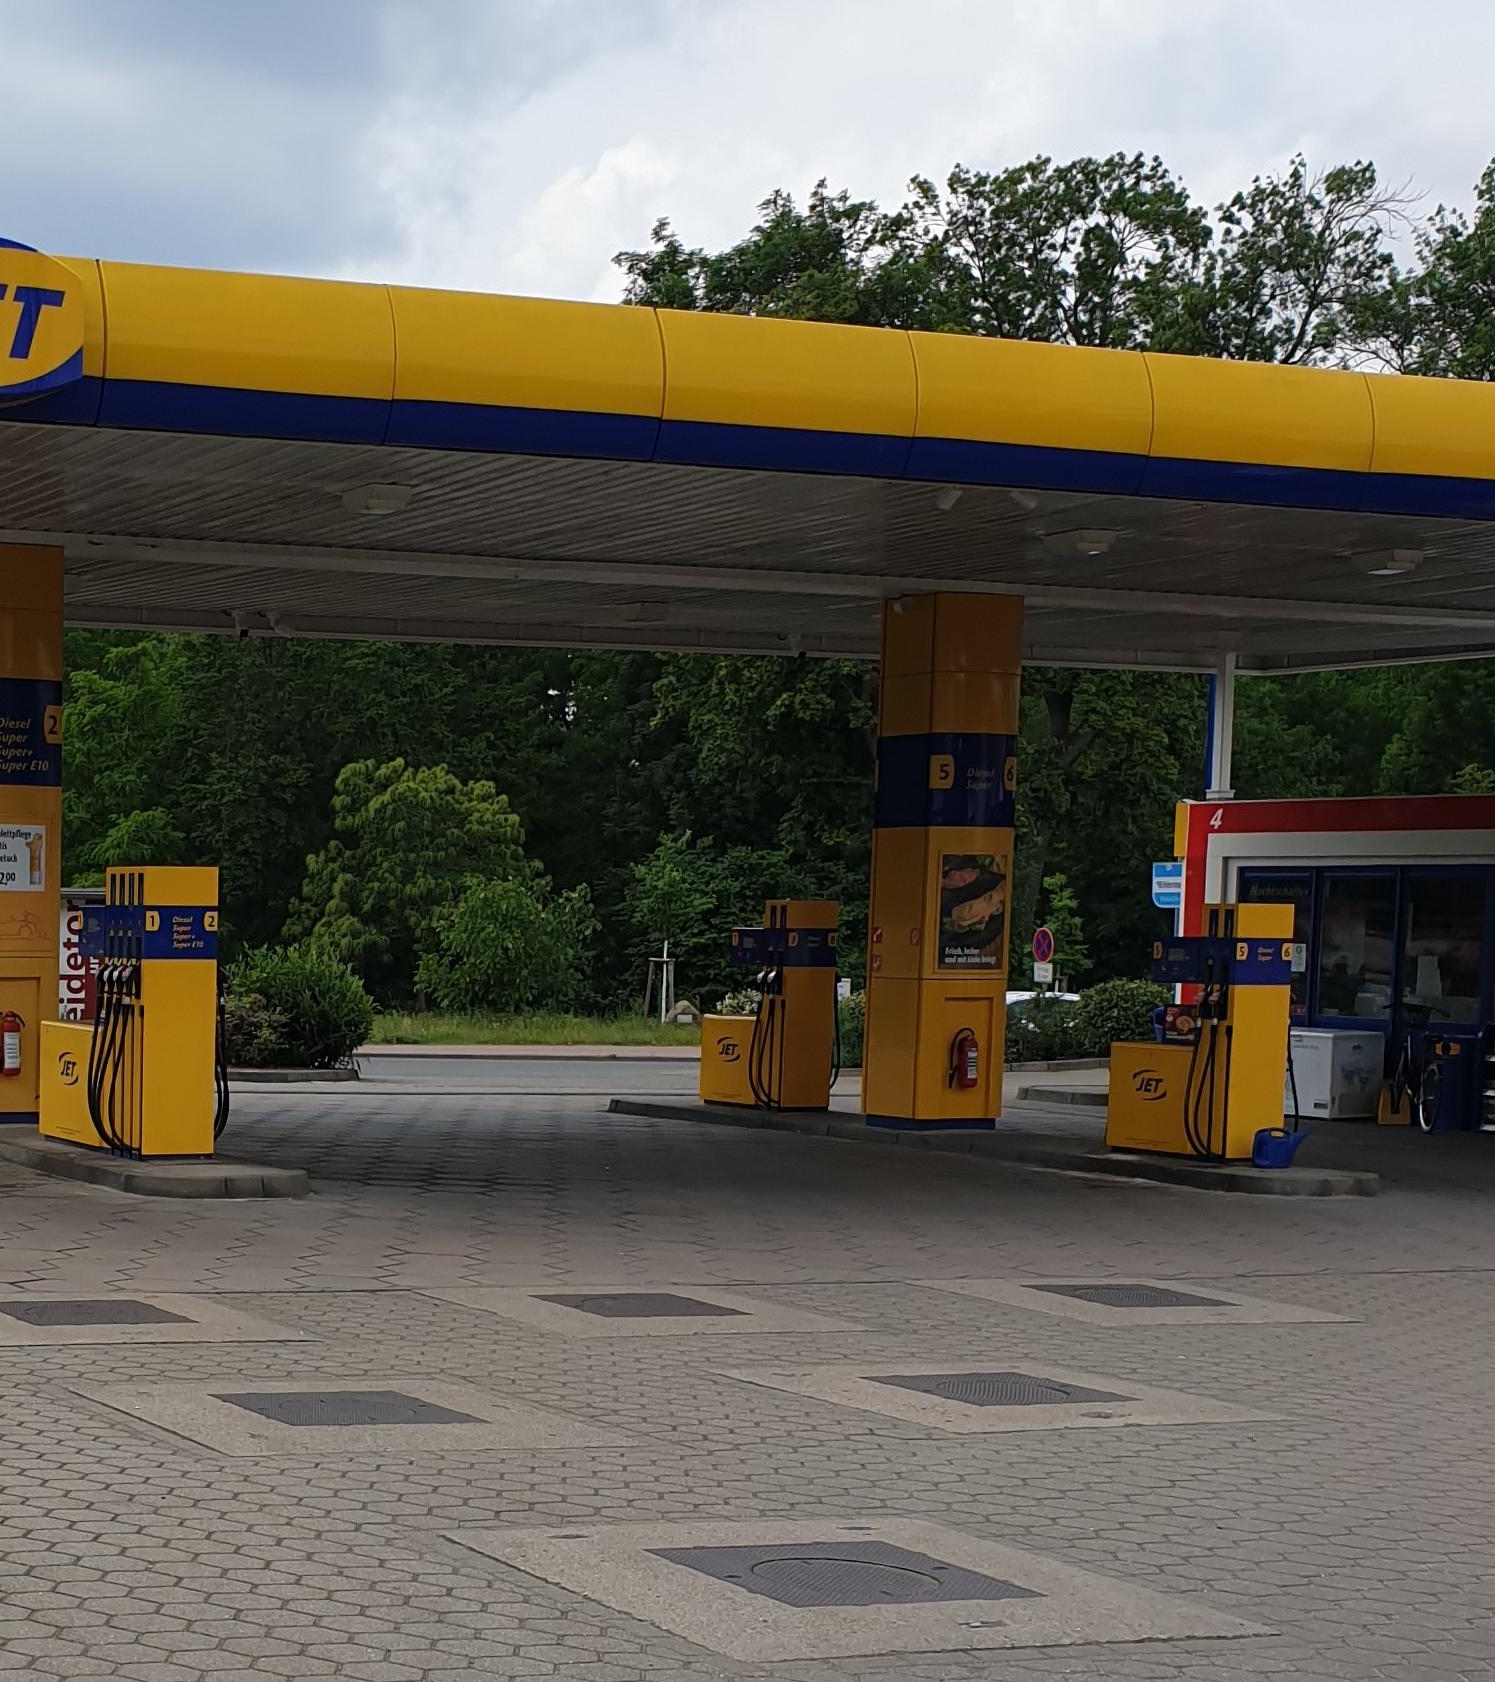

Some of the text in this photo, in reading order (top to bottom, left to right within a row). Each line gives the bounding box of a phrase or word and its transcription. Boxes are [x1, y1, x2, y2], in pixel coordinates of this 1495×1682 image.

[48, 715, 58, 735] 2
[30, 760, 49, 771] E10
[939, 764, 950, 780] 5
[1007, 766, 1014, 782] 6
[1209, 808, 1223, 830] 4
[149, 915, 155, 927] 1
[208, 915, 215, 927] 2
[1239, 946, 1245, 957] 5
[1284, 946, 1290, 957] 6
[719, 1043, 739, 1056] JET
[60, 1060, 77, 1077] JET
[1136, 1077, 1164, 1093] JET
